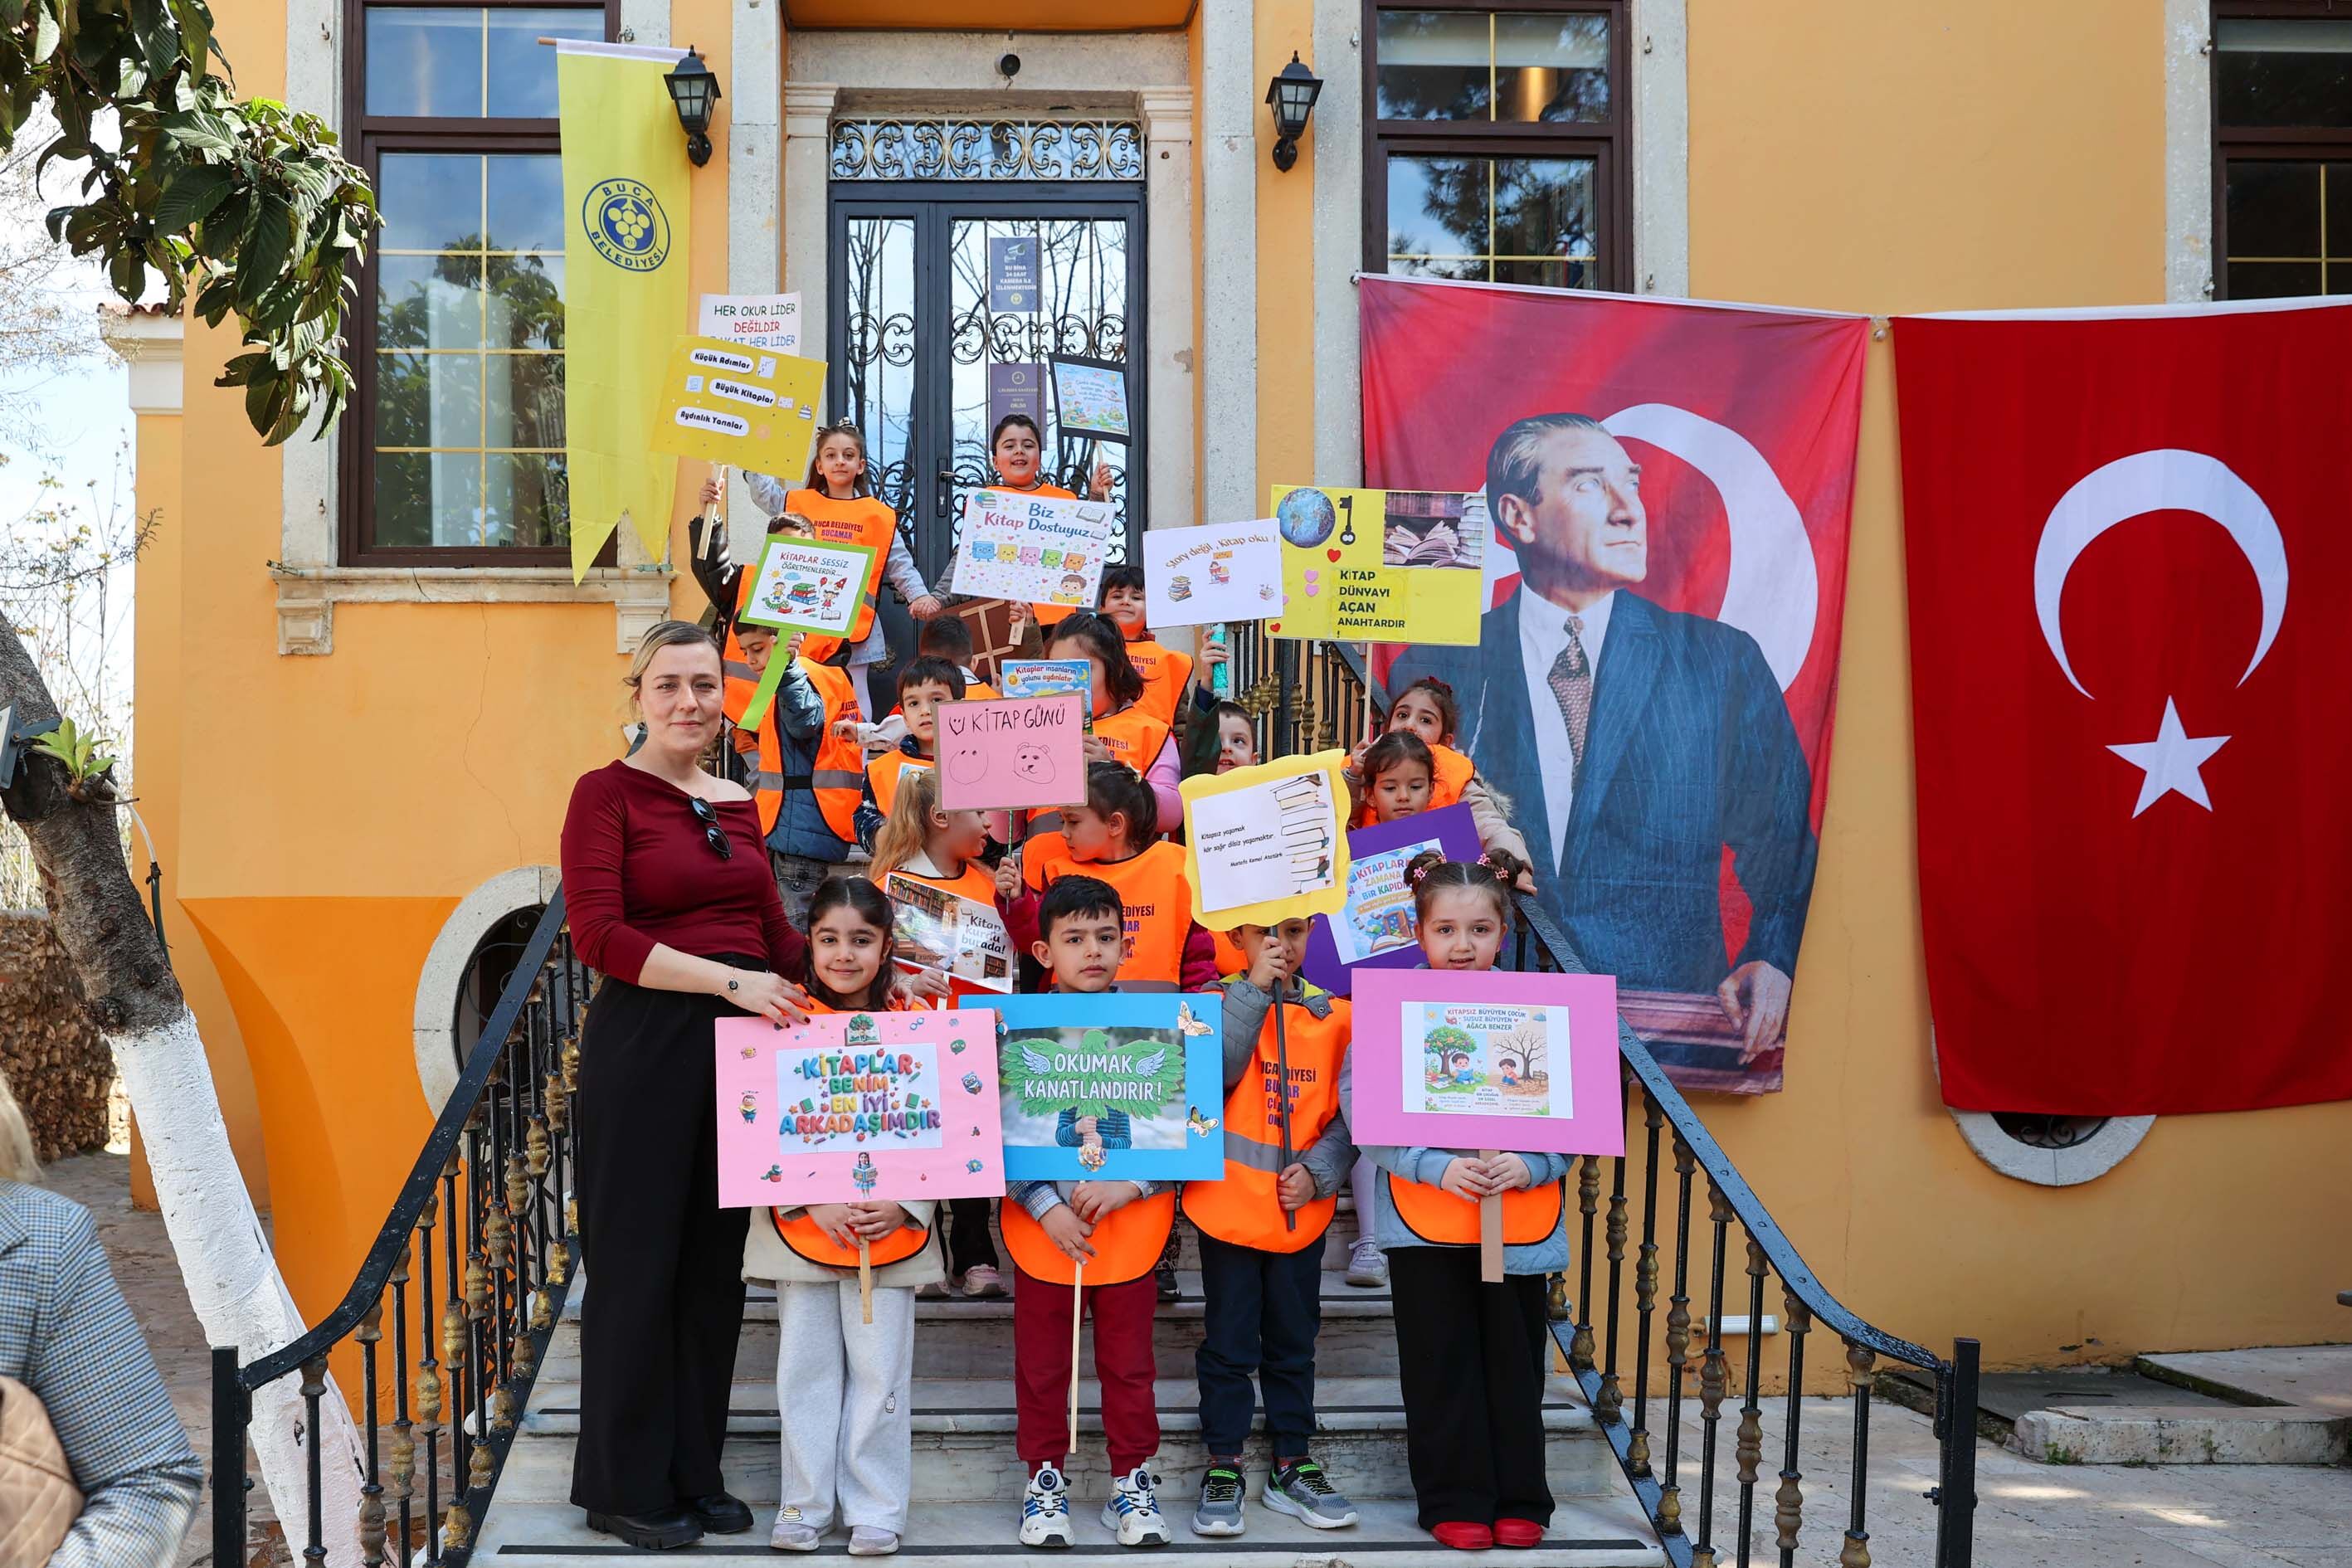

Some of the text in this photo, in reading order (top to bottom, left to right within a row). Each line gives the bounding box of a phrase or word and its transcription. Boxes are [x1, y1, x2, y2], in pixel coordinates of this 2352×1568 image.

[602, 183, 654, 207] BUCA
[592, 231, 664, 268] BELEDİYESİ
[714, 302, 796, 316] HER OKUR LİDER
[734, 319, 781, 333] DEĞİLDİR
[749, 336, 767, 348] HER
[771, 334, 796, 347] LİDER
[694, 353, 750, 369] Küçük Adımlar
[715, 382, 774, 404] Büyük Kitaplar
[680, 411, 743, 430] Aydınlık Yarınlar
[1028, 503, 1054, 519] Biz
[830, 521, 864, 533] BELEDİYESİ
[984, 511, 1090, 538] Kitap Dostuyuz
[821, 529, 853, 540] BUCAMAR
[1166, 552, 1190, 569] Story
[1189, 543, 1214, 556] değil
[1218, 537, 1245, 548] Kitap
[1248, 534, 1269, 543] oku
[780, 552, 850, 568] KİTAPLAR SESSİZ
[1340, 570, 1376, 581] KİTAP
[1339, 585, 1390, 597] DÜNYAYI
[1338, 601, 1376, 615] AÇAN
[1337, 617, 1405, 628] ANAHTARDIR
[1015, 665, 1077, 675] Kitaplar insanların
[1021, 674, 1073, 684] yolunu aydınlatır
[971, 704, 1065, 733] KİTAP GÜNÜ
[1223, 825, 1246, 836] yaşamak
[1364, 871, 1402, 887] ZAMANA
[1361, 889, 1377, 900] BİR
[1122, 903, 1155, 918] EDİYESİ
[971, 916, 1001, 932] Kitap
[802, 1052, 913, 1080] KİTAPLAR
[1054, 1053, 1133, 1074] OKUMAK
[829, 1074, 889, 1095] BENİM
[831, 1093, 889, 1113] EN İYİ
[779, 1109, 942, 1137] ARKADAŞIMDIR
